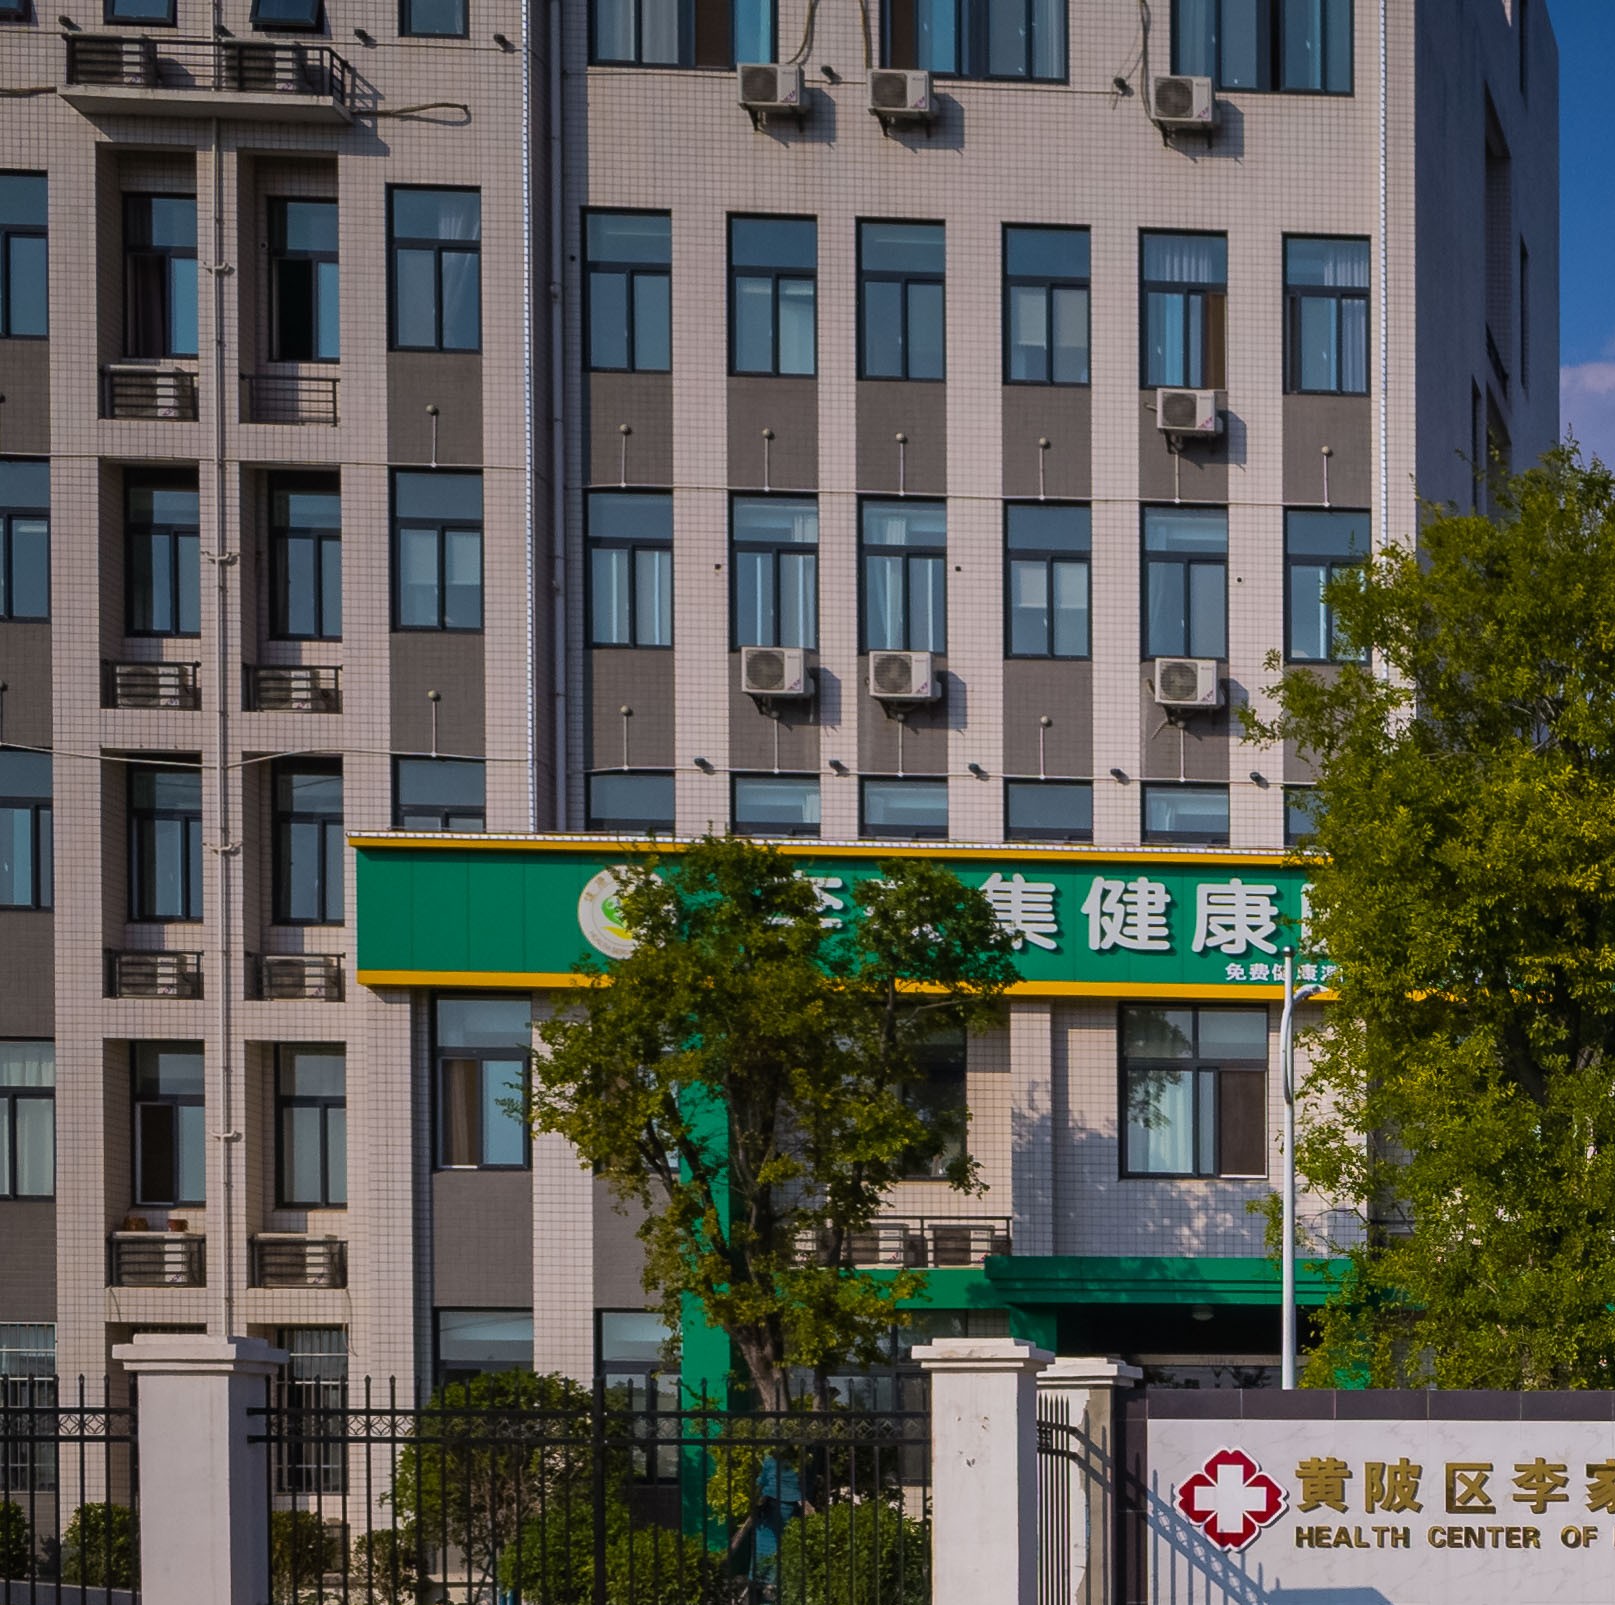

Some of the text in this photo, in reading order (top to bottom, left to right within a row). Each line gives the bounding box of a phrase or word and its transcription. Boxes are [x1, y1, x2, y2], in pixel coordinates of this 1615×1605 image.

[1295, 1525, 1411, 1550] HEALTH
[1427, 1525, 1541, 1550] CENTER
[1560, 1525, 1599, 1550] OF
